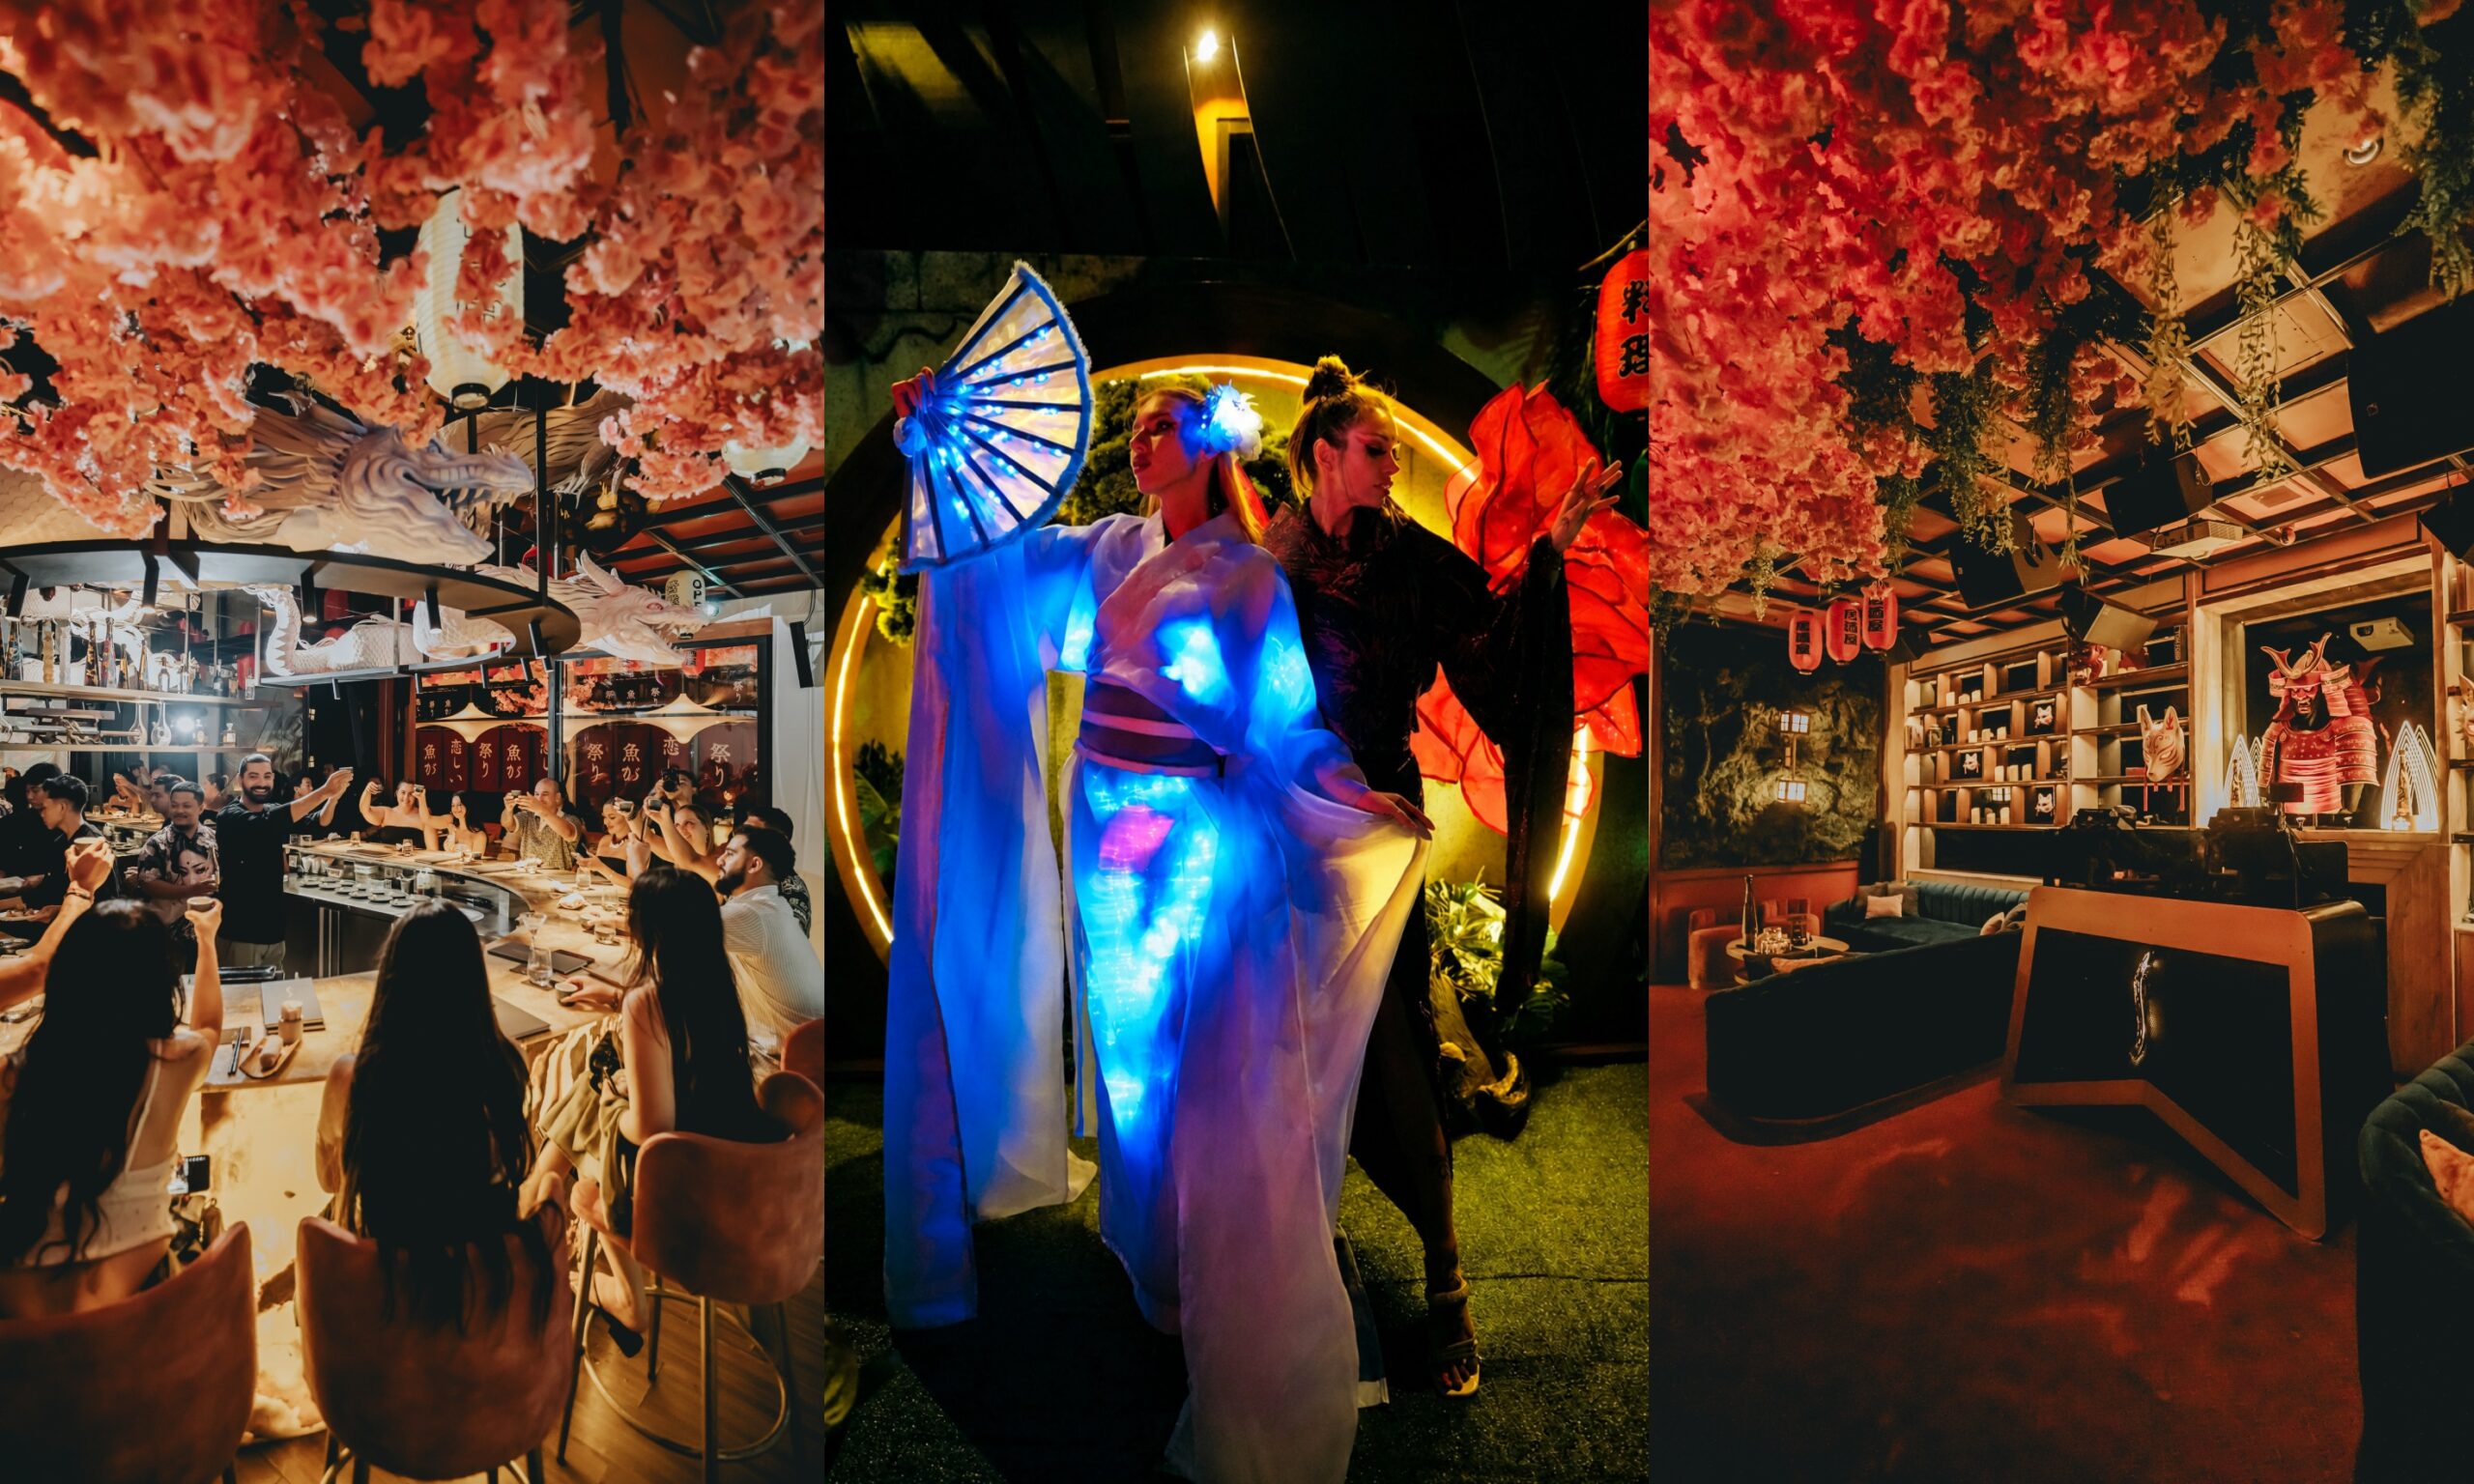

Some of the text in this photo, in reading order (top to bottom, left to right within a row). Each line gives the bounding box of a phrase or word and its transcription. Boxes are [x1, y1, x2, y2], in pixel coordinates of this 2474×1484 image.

[423, 743, 437, 776] 魚が
[449, 738, 463, 784] 恋しい
[478, 742, 493, 779] 祭り
[505, 743, 522, 779] 魚が
[587, 742, 604, 783] 祭り
[620, 742, 642, 782] 魚が
[709, 742, 732, 788] 祭り
